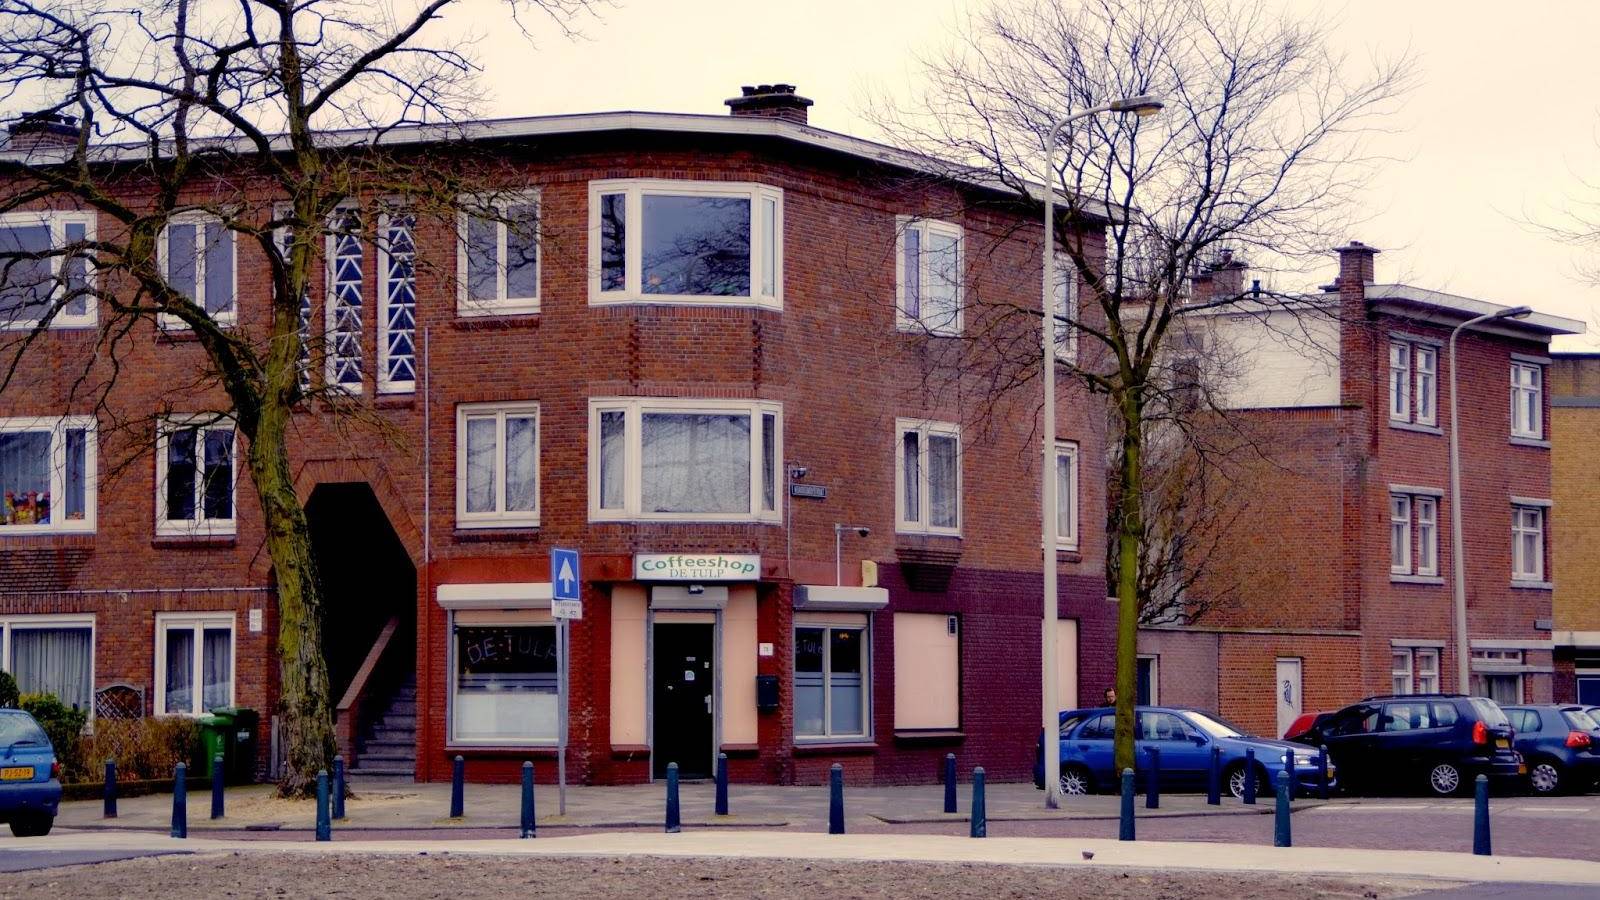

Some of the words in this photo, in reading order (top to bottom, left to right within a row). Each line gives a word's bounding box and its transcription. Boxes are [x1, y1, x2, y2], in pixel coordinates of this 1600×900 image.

[641, 556, 755, 574] Coffeeshop
[669, 568, 688, 578] DE
[689, 568, 725, 578] TULP
